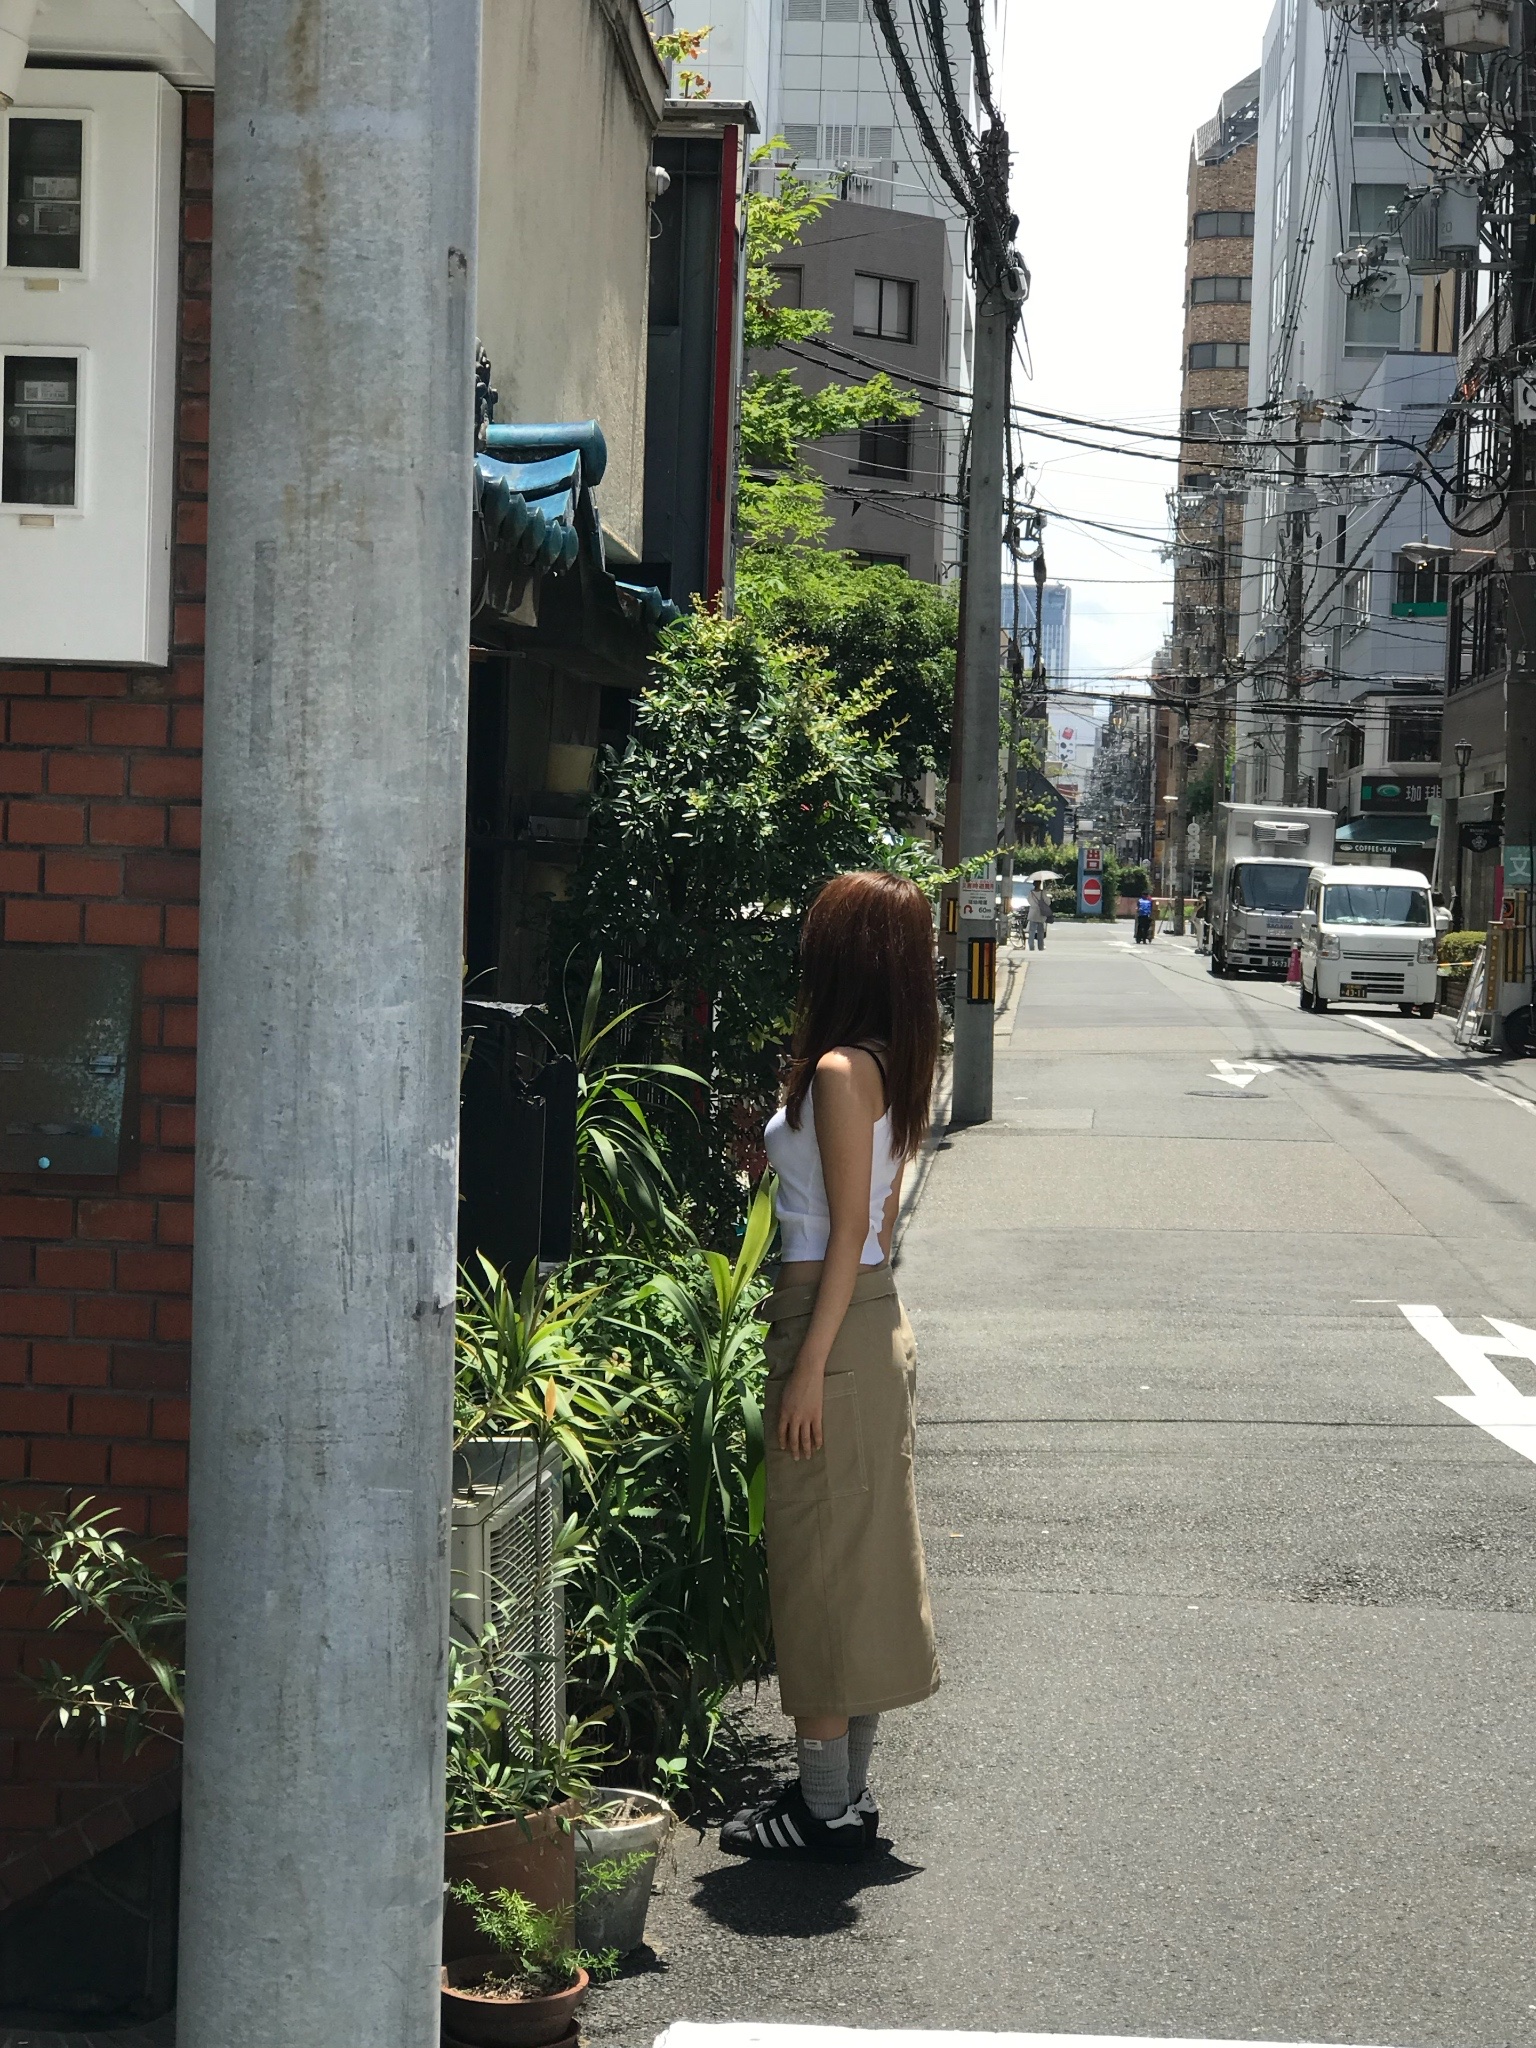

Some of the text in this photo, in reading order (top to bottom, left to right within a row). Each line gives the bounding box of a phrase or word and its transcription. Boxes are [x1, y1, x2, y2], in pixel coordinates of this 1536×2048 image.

[1405, 784, 1441, 802] 珈琲
[1086, 849, 1100, 869] 出口
[1508, 853, 1532, 877] 文
